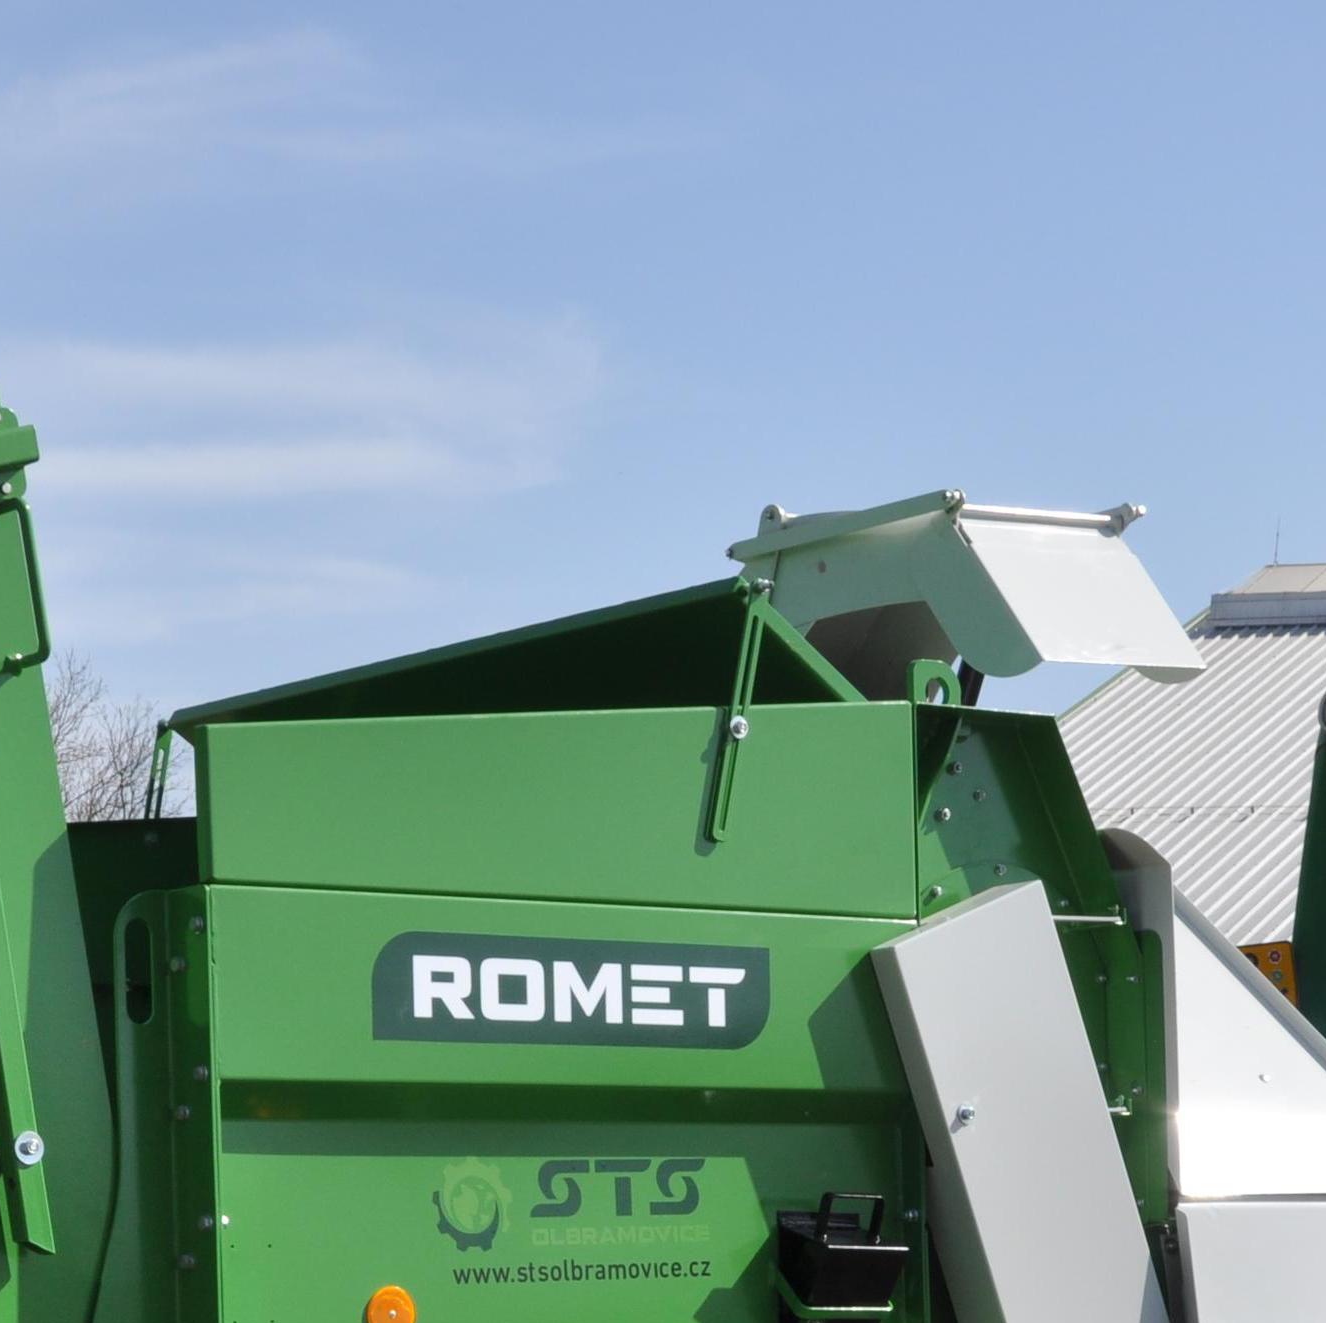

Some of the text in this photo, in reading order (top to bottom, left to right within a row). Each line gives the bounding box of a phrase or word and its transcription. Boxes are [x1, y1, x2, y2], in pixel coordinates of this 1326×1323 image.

[412, 954, 746, 1028] ROMET
[530, 1158, 706, 1218] STS
[531, 1224, 710, 1246] OLBRAMOVICE
[453, 1259, 711, 1285] www.stsolbramovice.cz
